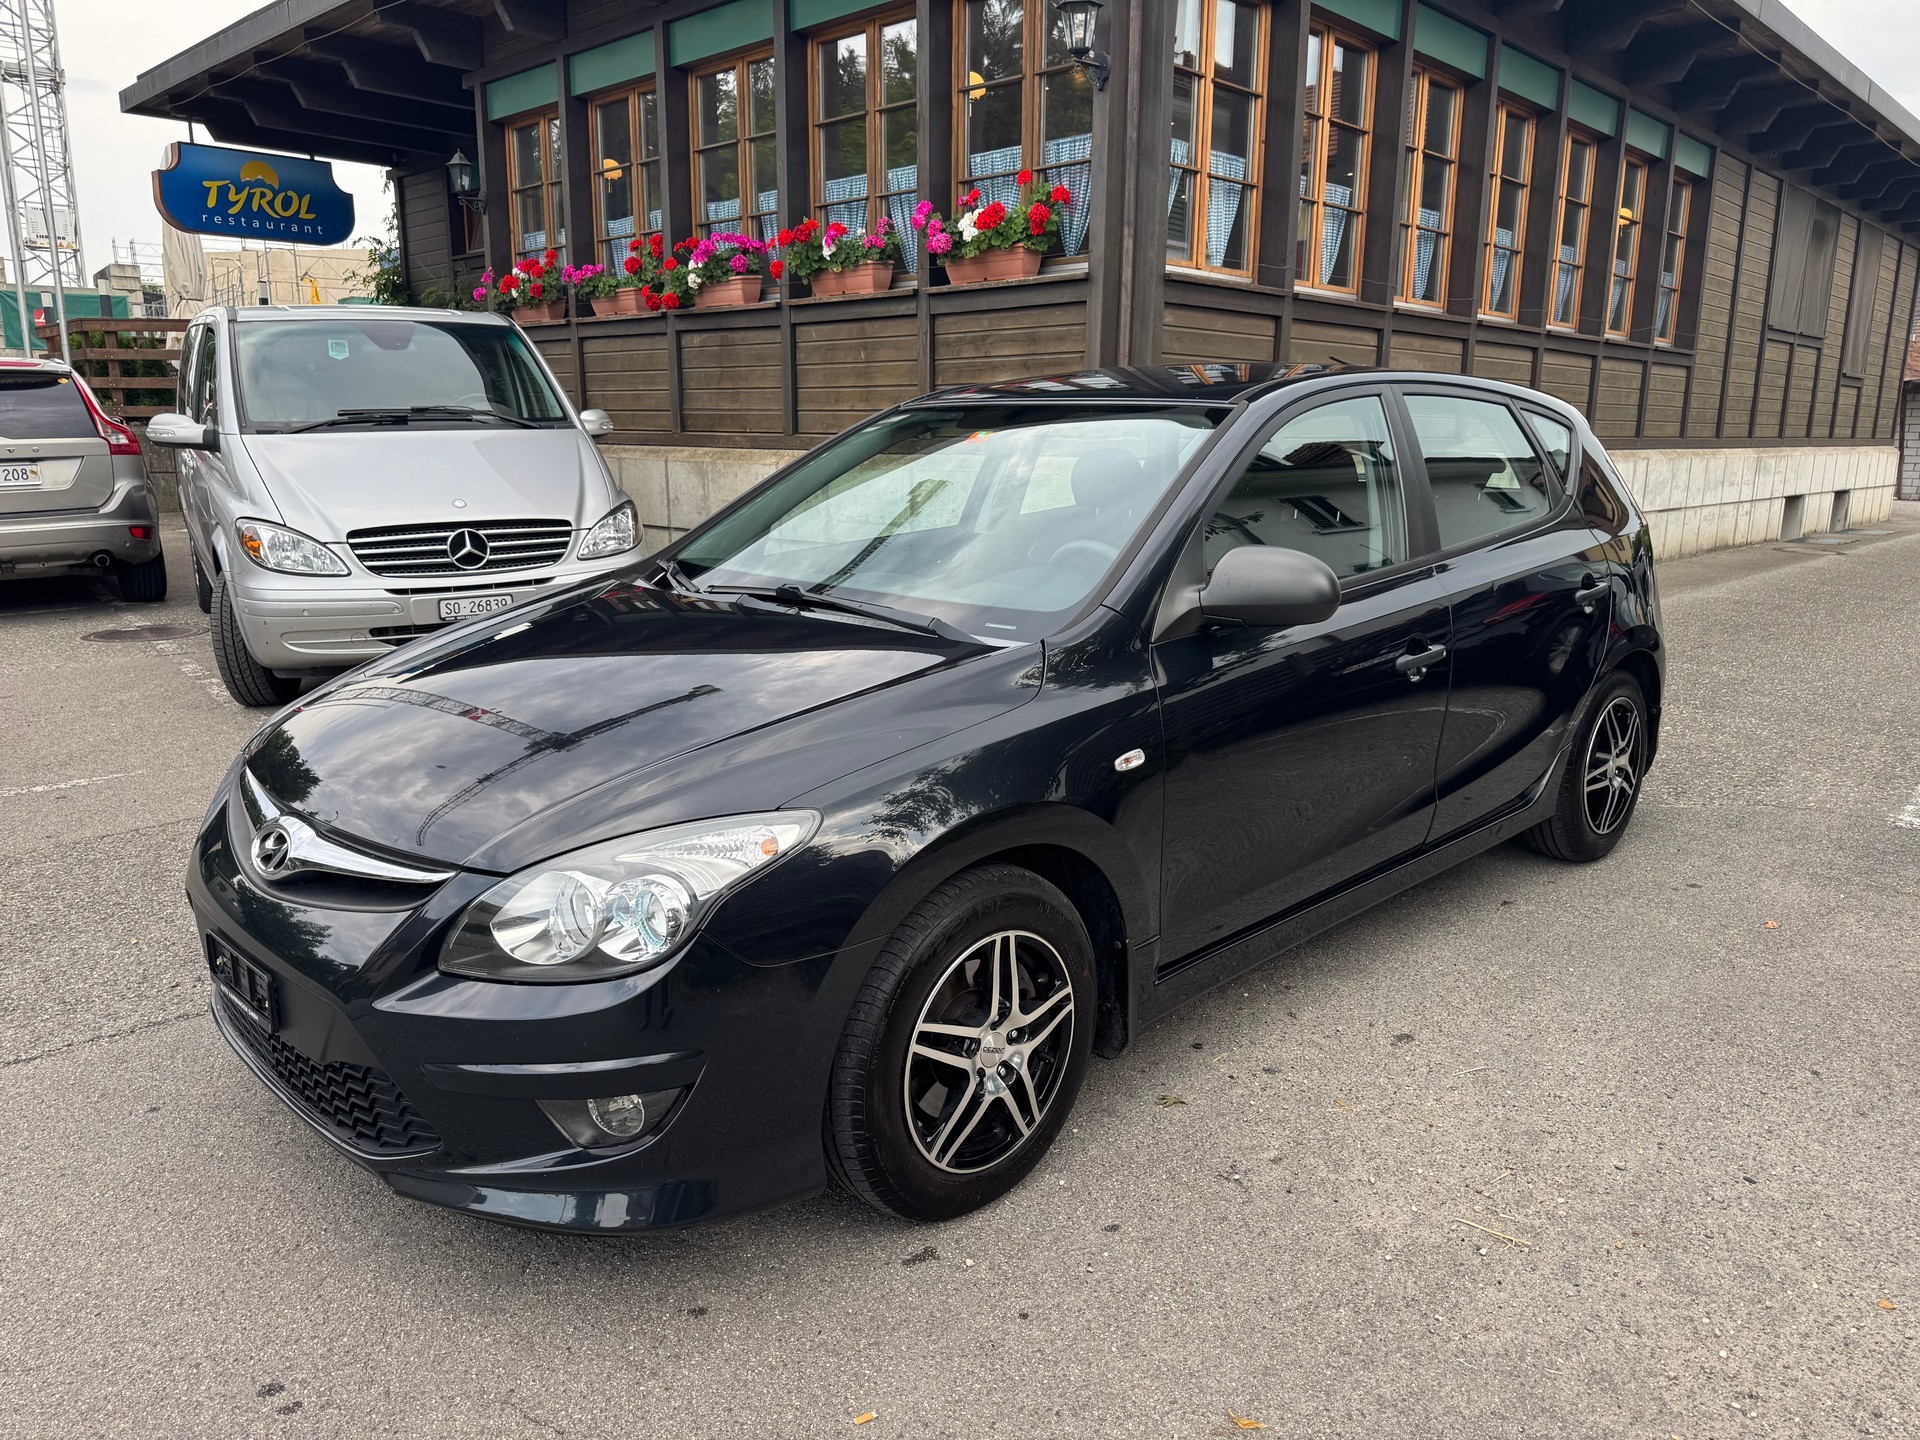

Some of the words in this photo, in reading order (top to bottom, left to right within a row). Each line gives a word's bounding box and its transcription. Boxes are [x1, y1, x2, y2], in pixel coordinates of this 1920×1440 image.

[202, 180, 316, 219] TYROL
[202, 214, 323, 235] restaurant
[2, 468, 29, 481] 208
